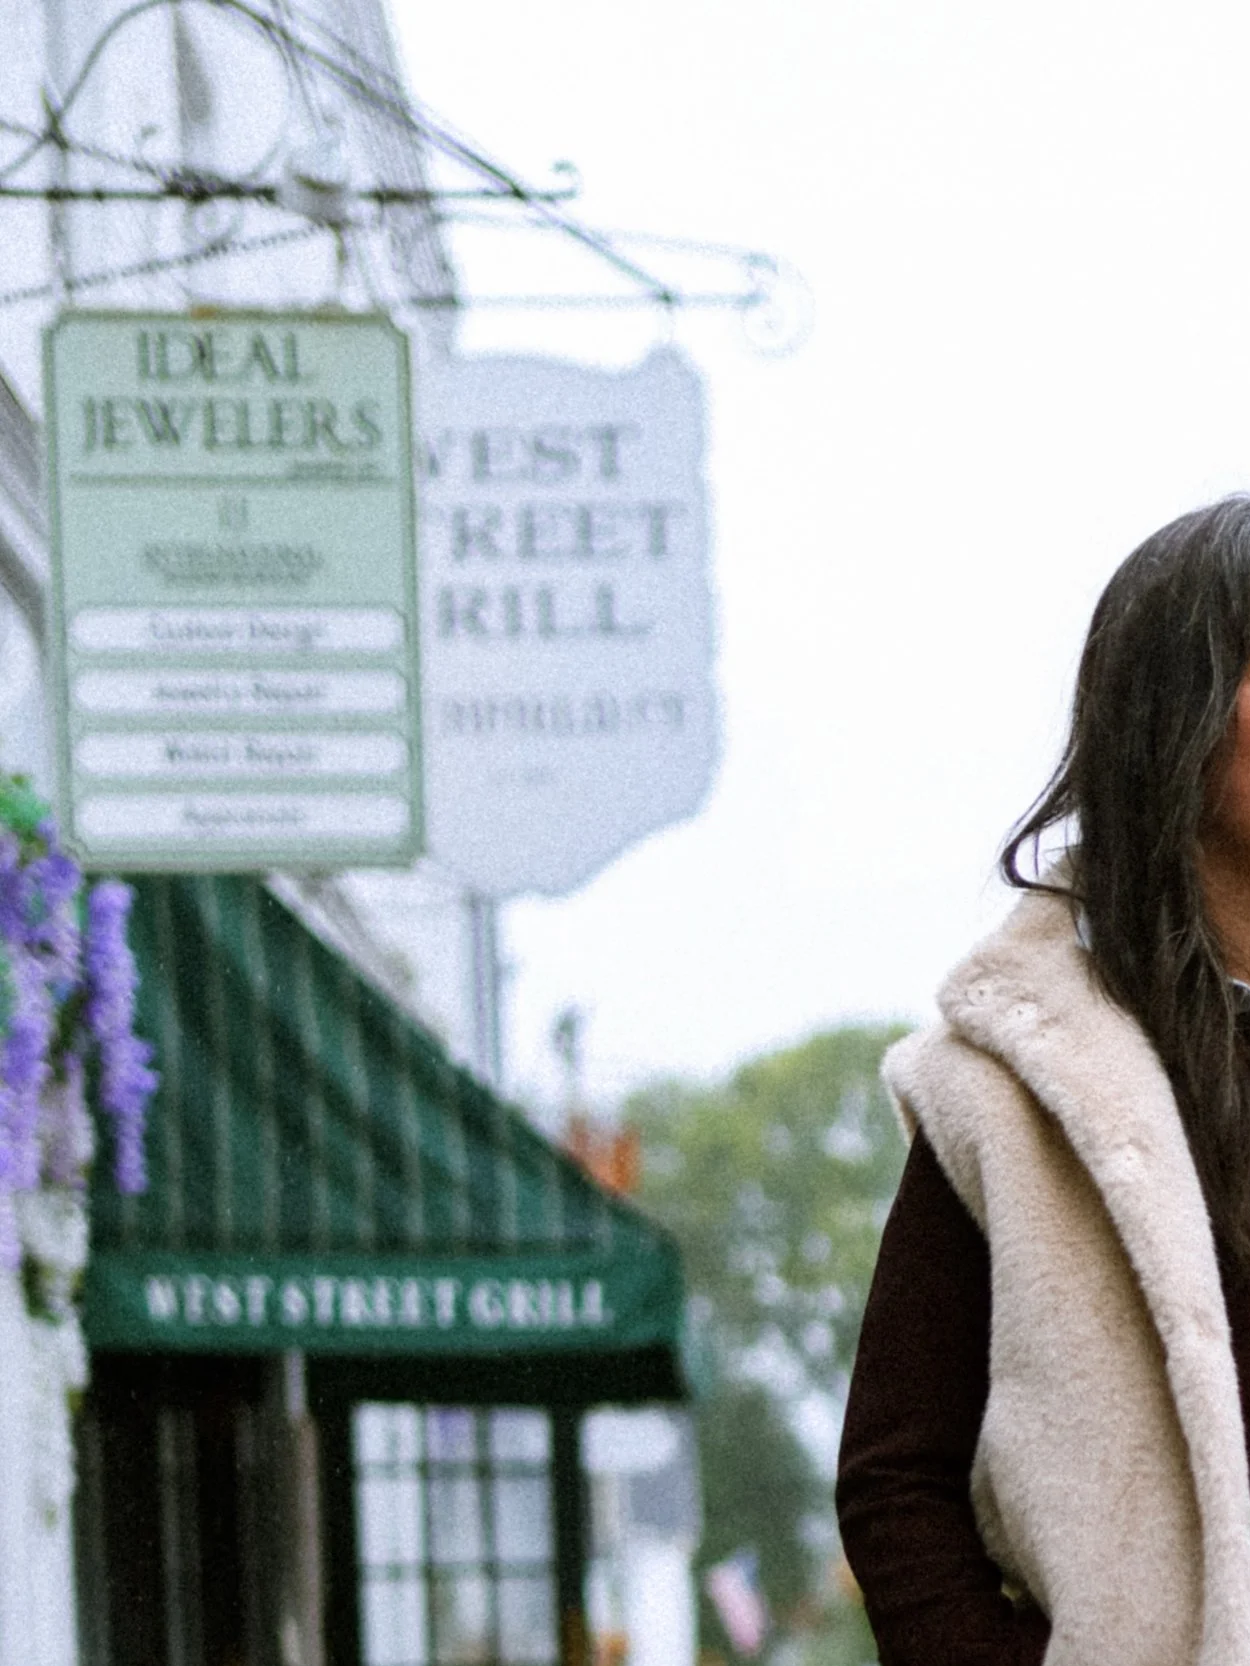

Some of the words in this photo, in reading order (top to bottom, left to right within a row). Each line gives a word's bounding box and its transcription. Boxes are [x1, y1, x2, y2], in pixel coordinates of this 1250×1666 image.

[136, 330, 318, 383] IDEAL
[78, 396, 384, 453] JEWELERS
[420, 499, 688, 562] REET
[433, 581, 657, 643] RILL
[145, 1273, 273, 1325] WEST
[279, 1275, 462, 1329] STREET
[467, 1276, 614, 1331] GRILL
